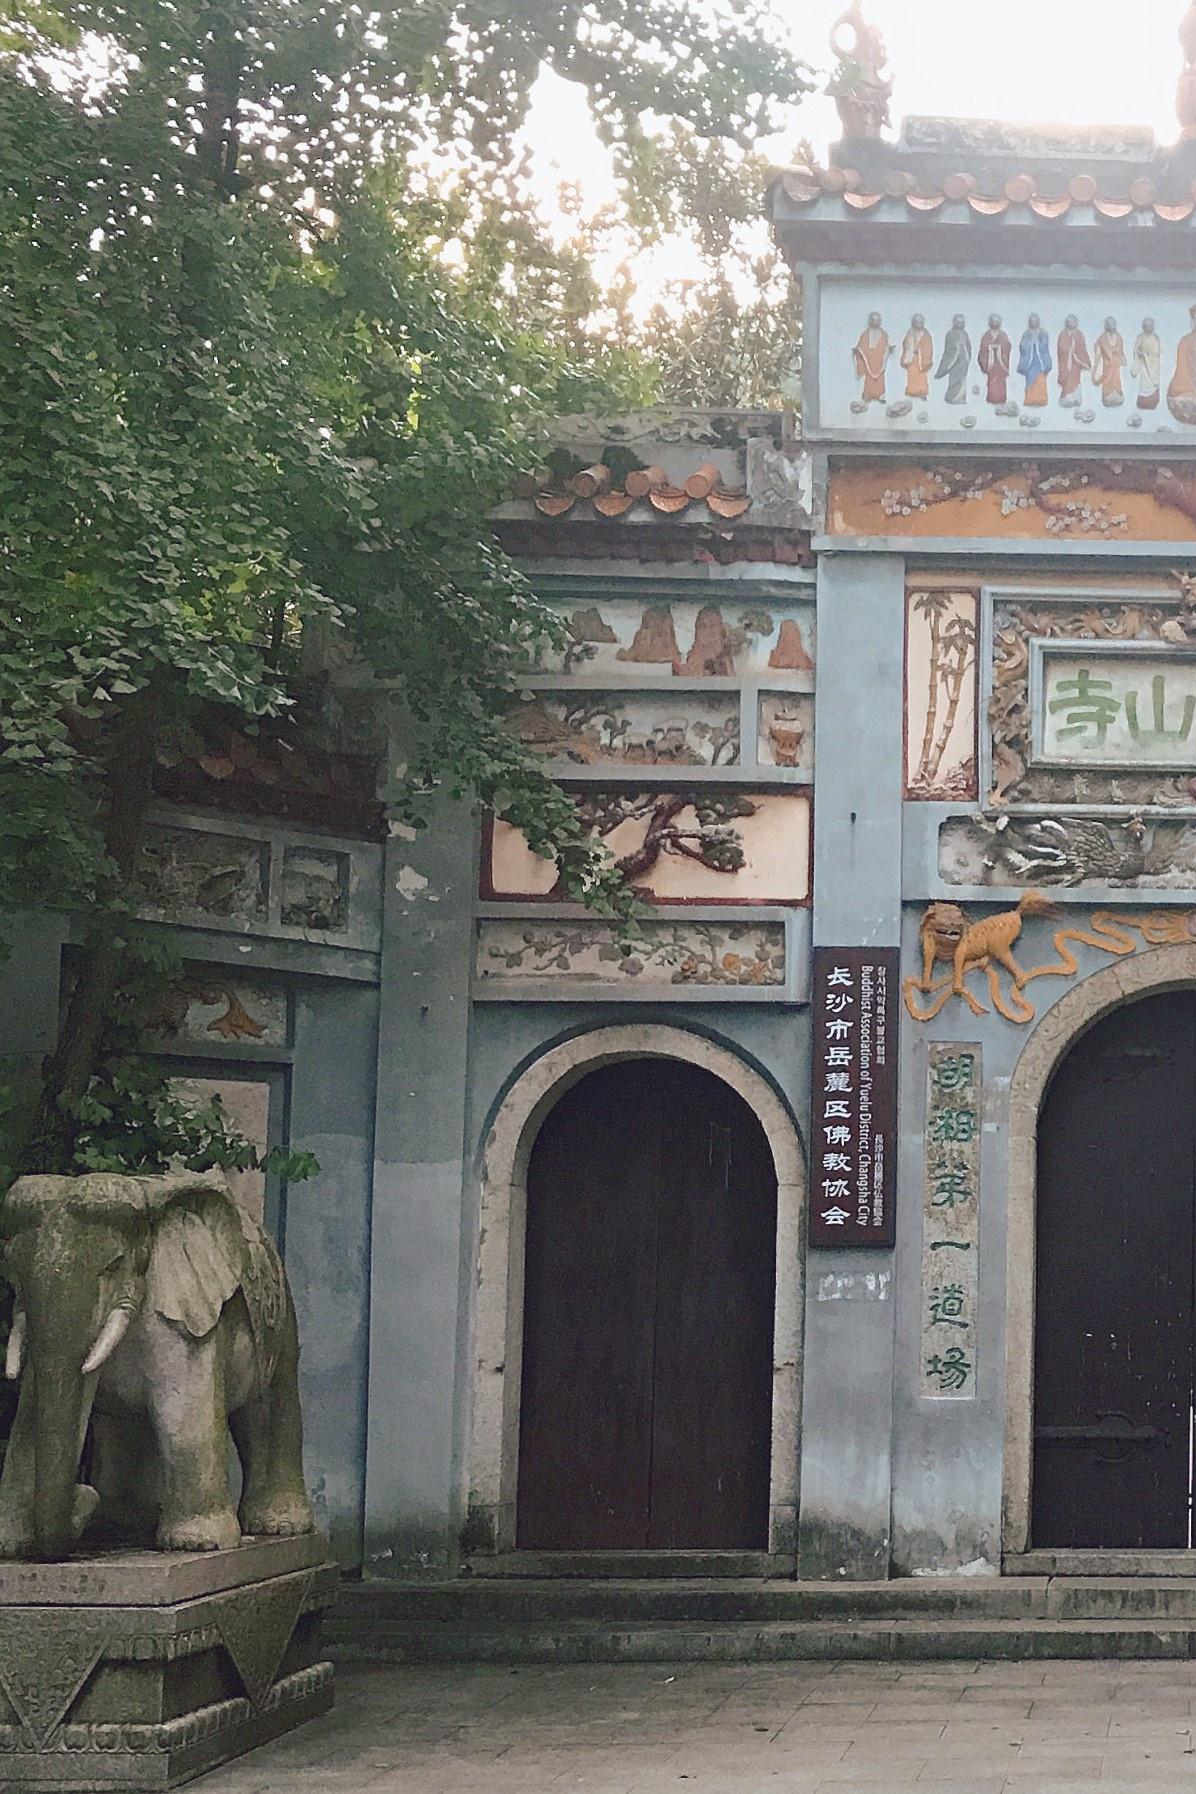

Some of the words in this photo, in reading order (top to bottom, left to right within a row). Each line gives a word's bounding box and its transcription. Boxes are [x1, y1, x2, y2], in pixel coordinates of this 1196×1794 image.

[861, 965, 874, 1010] Buddhist
[860, 1012, 873, 1069] Association
[820, 966, 854, 1226] 长沙市岳麓区佛教协会
[859, 1082, 873, 1111] Yuelu
[860, 1071, 873, 1082] of
[856, 1154, 871, 1204] Changsha
[856, 1206, 870, 1227] City
